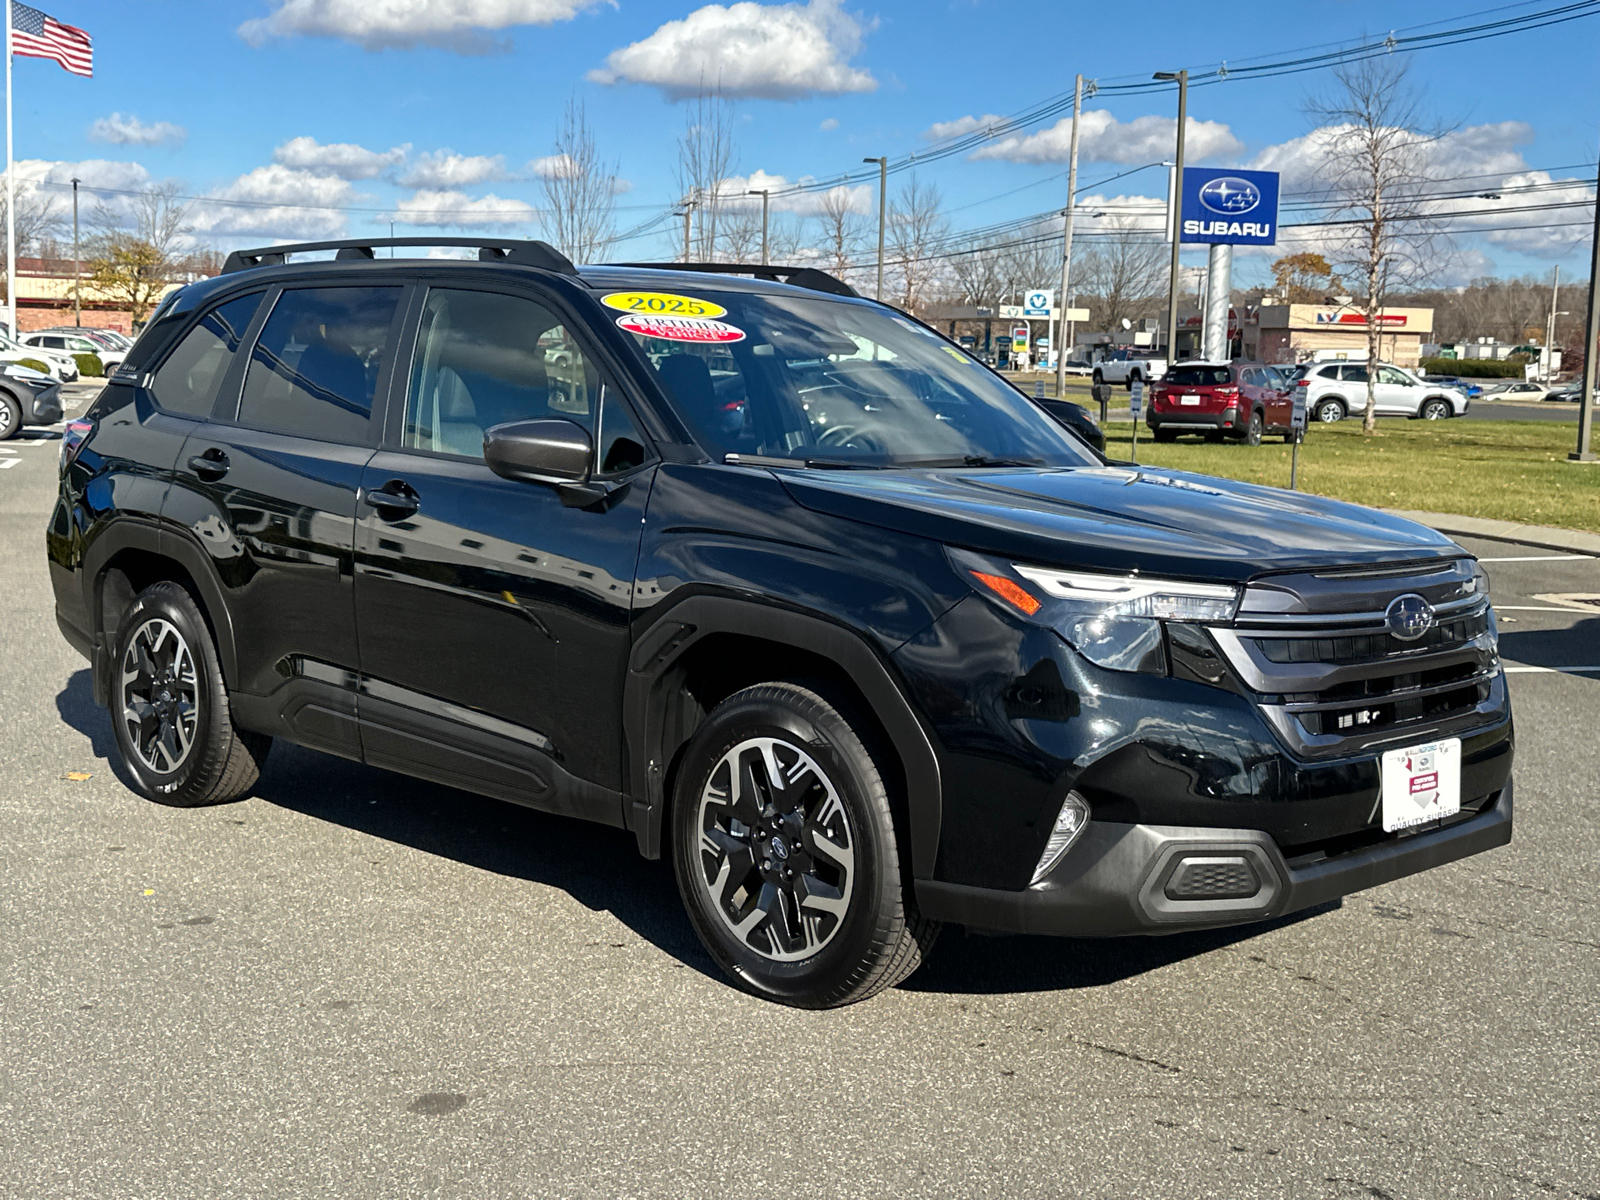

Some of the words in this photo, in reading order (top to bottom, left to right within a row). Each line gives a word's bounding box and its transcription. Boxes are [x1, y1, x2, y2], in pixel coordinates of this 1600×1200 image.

[1184, 220, 1270, 237] SUBARU
[627, 297, 706, 315] 2025
[631, 317, 728, 332] CERTIFIED
[639, 325, 729, 337] PRE-OWNED
[656, 330, 721, 340] VEHICLE
[1390, 816, 1425, 832] QUALITY
